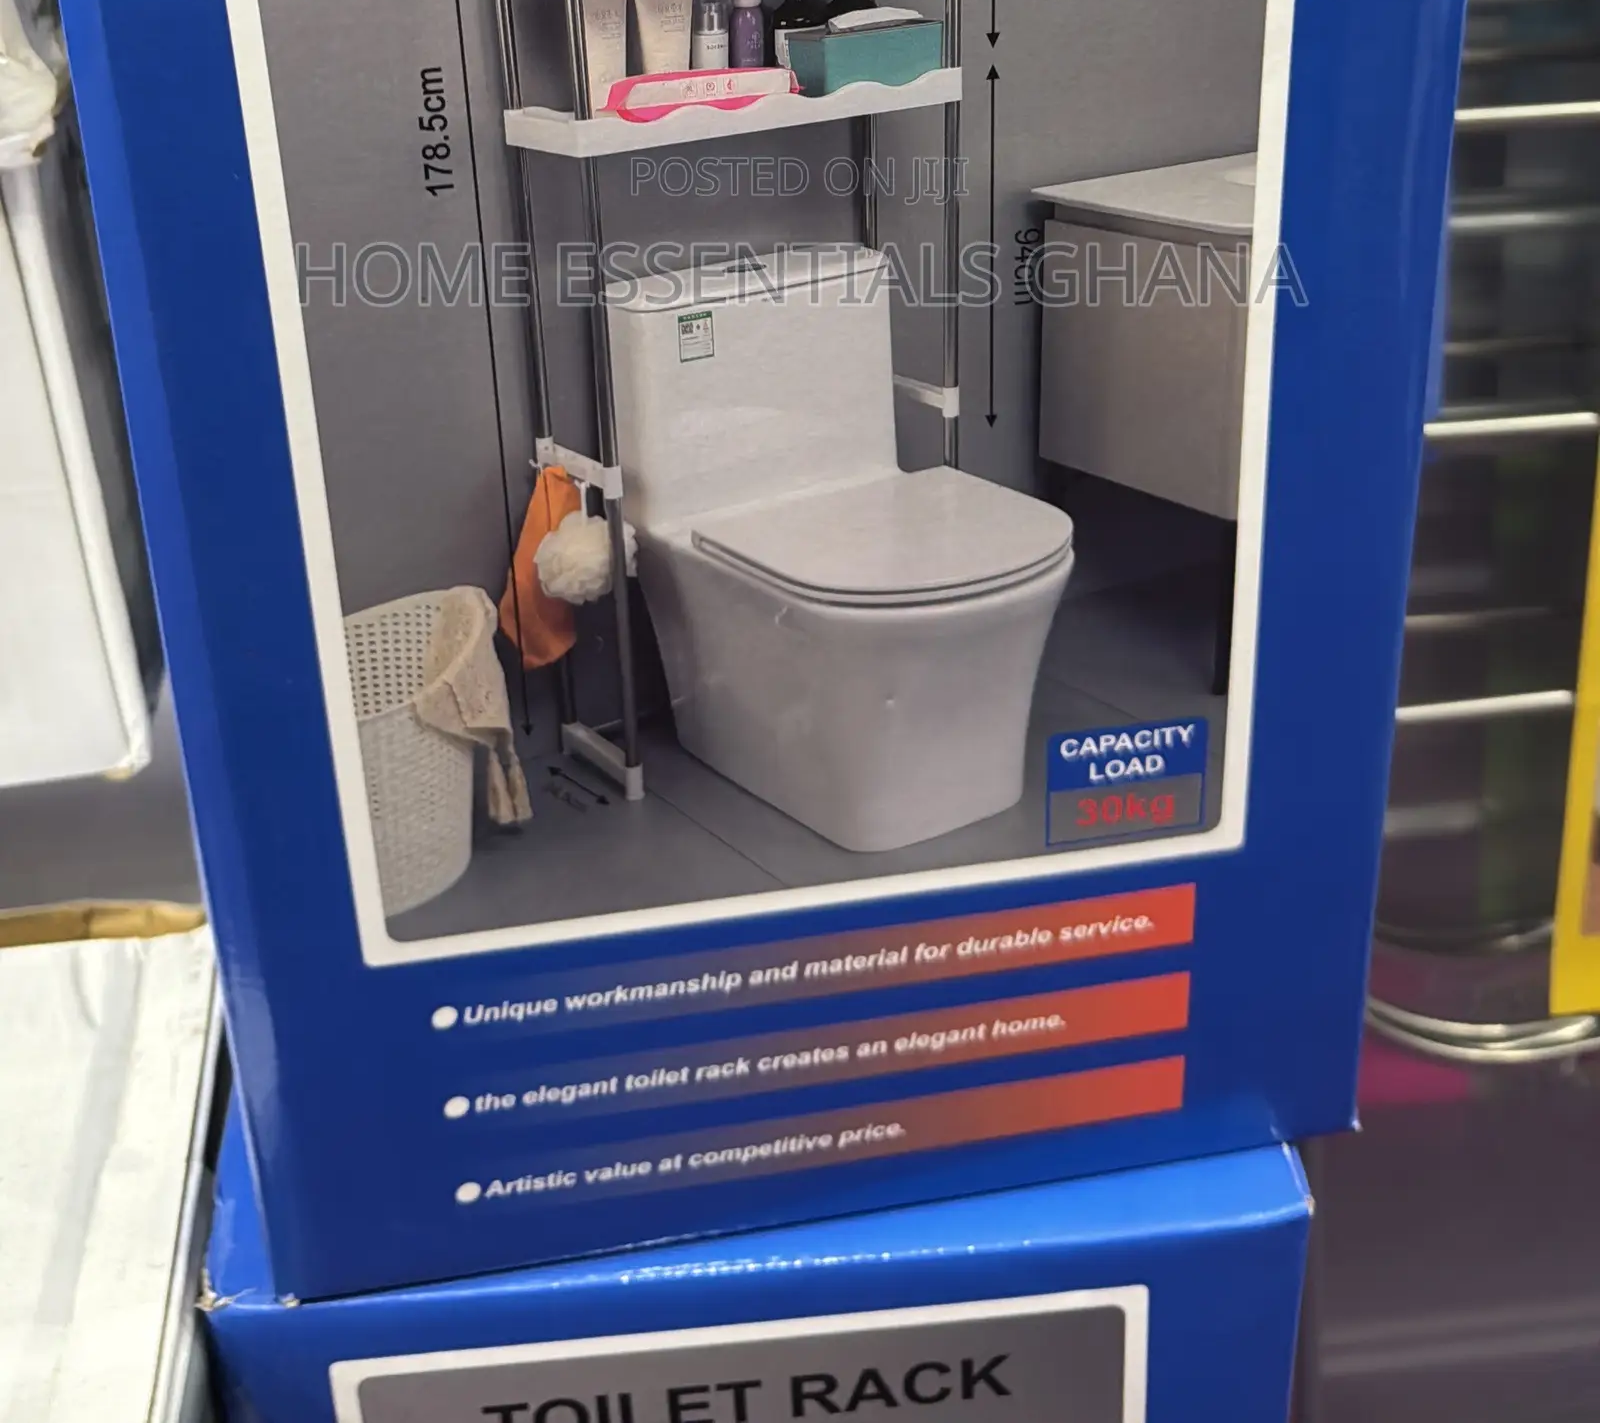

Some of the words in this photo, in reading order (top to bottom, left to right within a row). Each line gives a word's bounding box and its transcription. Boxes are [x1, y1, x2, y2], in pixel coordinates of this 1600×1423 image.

[418, 66, 455, 197] 178.5cm
[1013, 228, 1041, 306] 94cm
[1060, 723, 1196, 759] CAPACITY
[1089, 754, 1166, 783] LOAD
[1075, 792, 1176, 827] 30kg
[464, 998, 558, 1025] Unique
[564, 971, 742, 1011] workmanship
[748, 960, 799, 986] and
[803, 945, 908, 979] material
[913, 941, 952, 962] for
[956, 928, 1053, 960] durable
[1058, 911, 1156, 942] service.
[474, 1093, 517, 1114] the
[522, 1077, 619, 1108] elegant
[624, 1066, 690, 1091] toilet
[695, 1057, 751, 1081] rack
[756, 1042, 850, 1073] creates
[856, 1039, 888, 1059] an
[894, 1022, 986, 1054] elegant
[991, 1012, 1067, 1040] home.
[485, 1167, 579, 1198] Artistic
[584, 1160, 653, 1184] value
[658, 1155, 683, 1174] at
[687, 1131, 834, 1169] competitive
[837, 1120, 907, 1147] price.
[788, 1354, 1012, 1417] RACK
